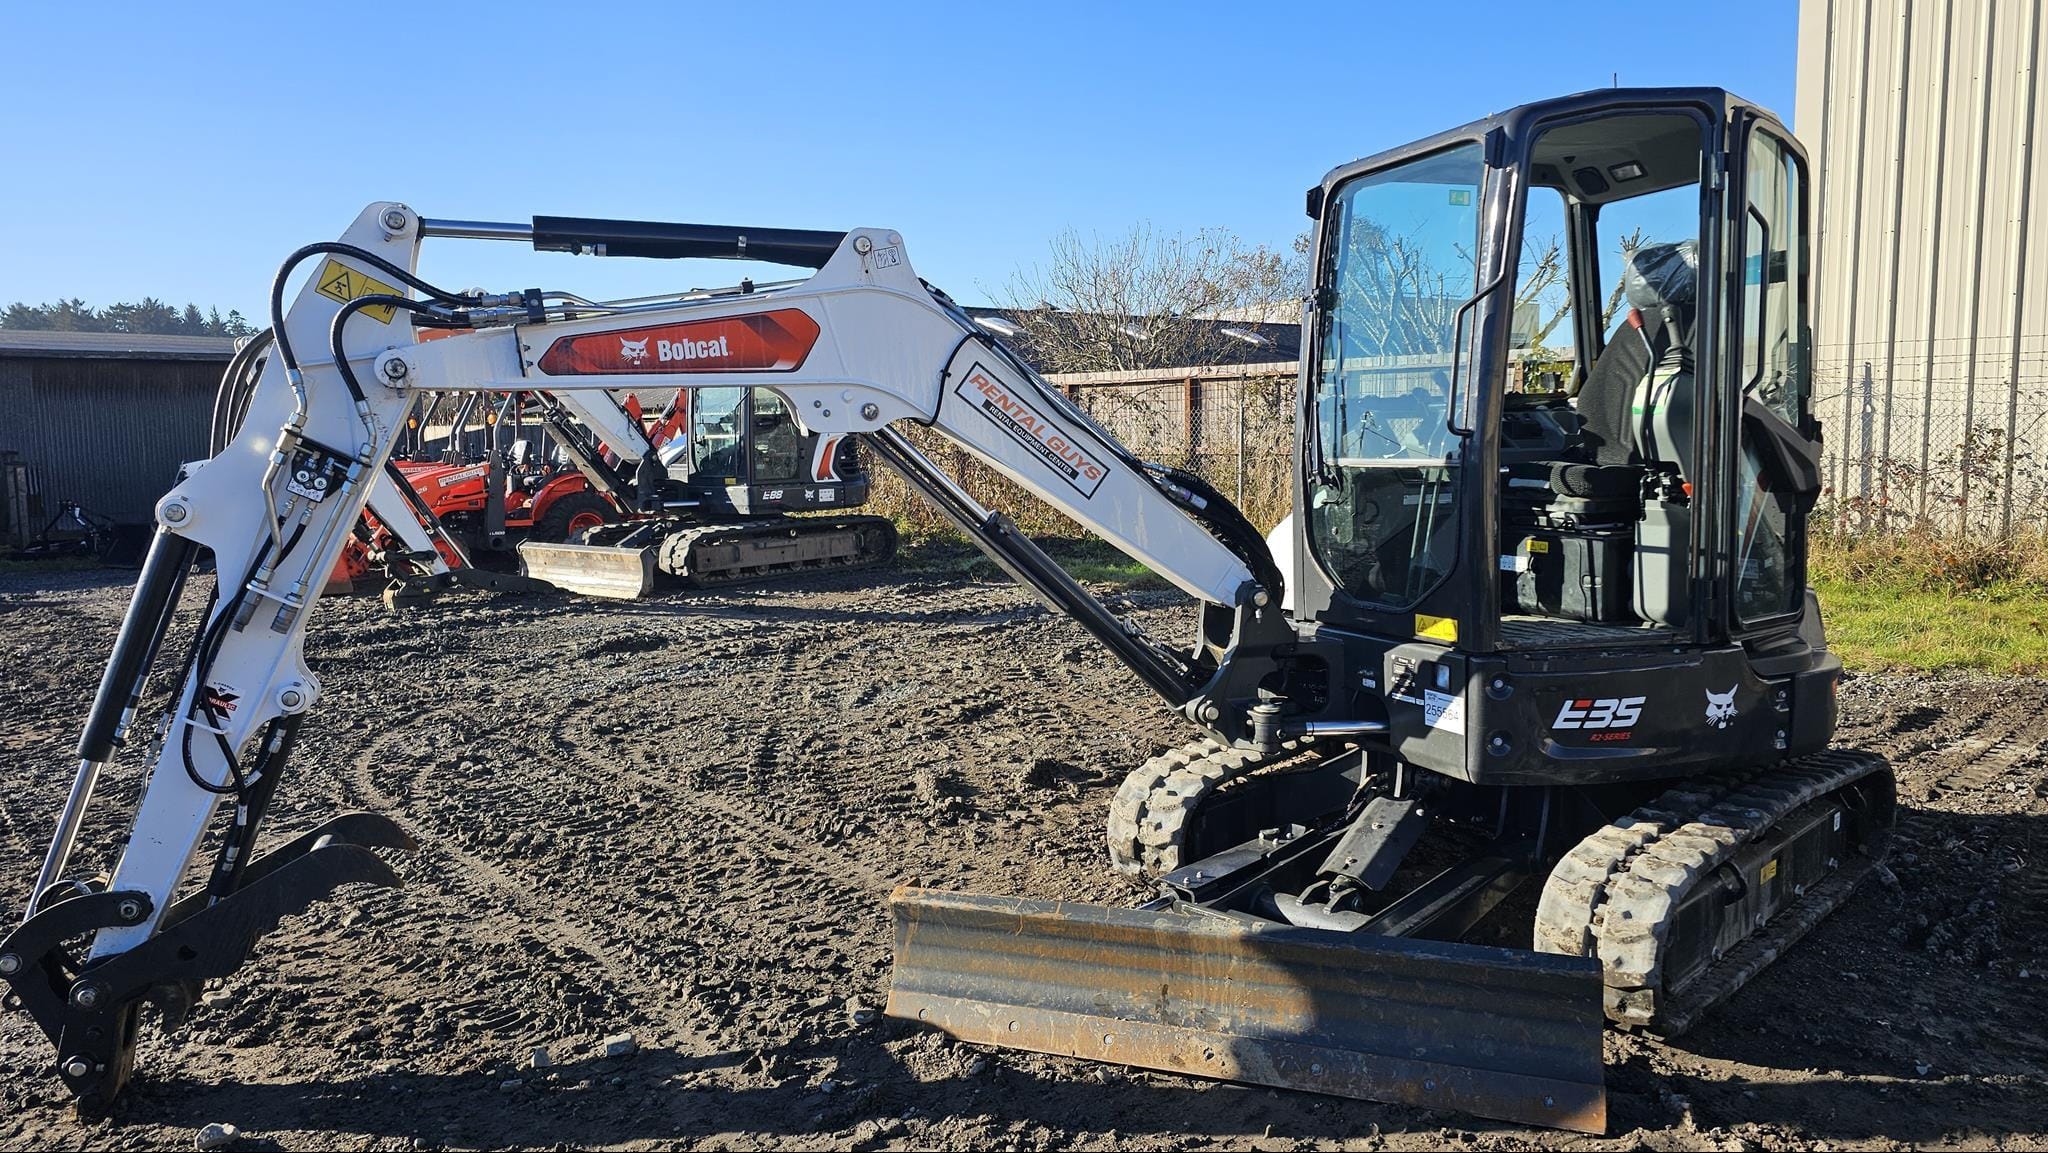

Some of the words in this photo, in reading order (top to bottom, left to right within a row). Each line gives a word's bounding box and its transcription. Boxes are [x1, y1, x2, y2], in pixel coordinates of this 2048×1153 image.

[657, 336, 729, 361] Bobcat
[969, 373, 1047, 439] RENTAL
[1046, 434, 1102, 481] GUYS
[988, 405, 1013, 428] RENTAL
[1012, 424, 1050, 457] EQUIPMENT
[1048, 452, 1073, 475] CENTER
[762, 490, 784, 500] E88
[1425, 703, 1459, 720] 255564
[1552, 696, 1647, 729] E35
